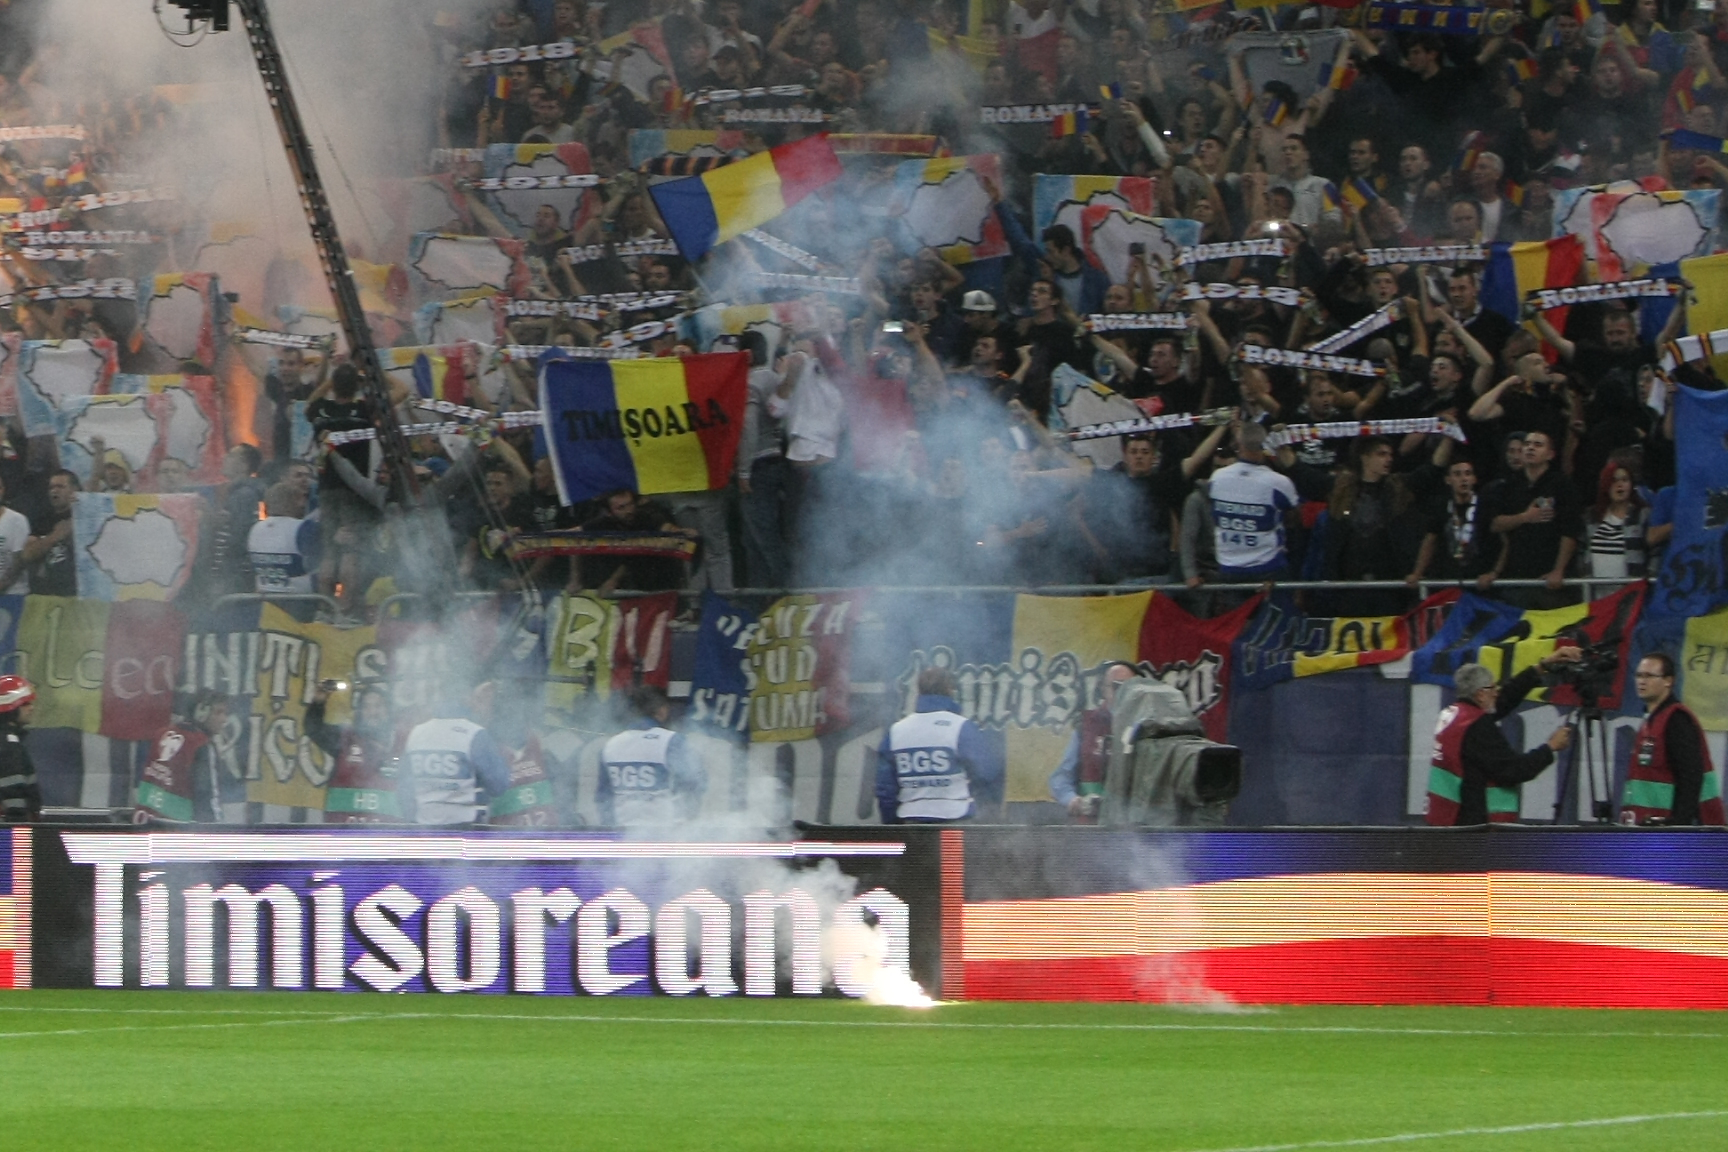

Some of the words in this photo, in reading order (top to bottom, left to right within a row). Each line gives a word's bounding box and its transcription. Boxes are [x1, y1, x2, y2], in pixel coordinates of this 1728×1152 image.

[464, 41, 576, 66] 1918
[724, 108, 824, 123] ROMANIA
[25, 230, 152, 246] ROMANIA
[1180, 239, 1285, 266] ROMANIA
[1364, 245, 1485, 266] ROMANIA
[1182, 281, 1302, 306] 1918
[1537, 278, 1670, 309] ROMANIA
[1243, 344, 1378, 377] ROMANIA
[897, 750, 952, 775] BGS
